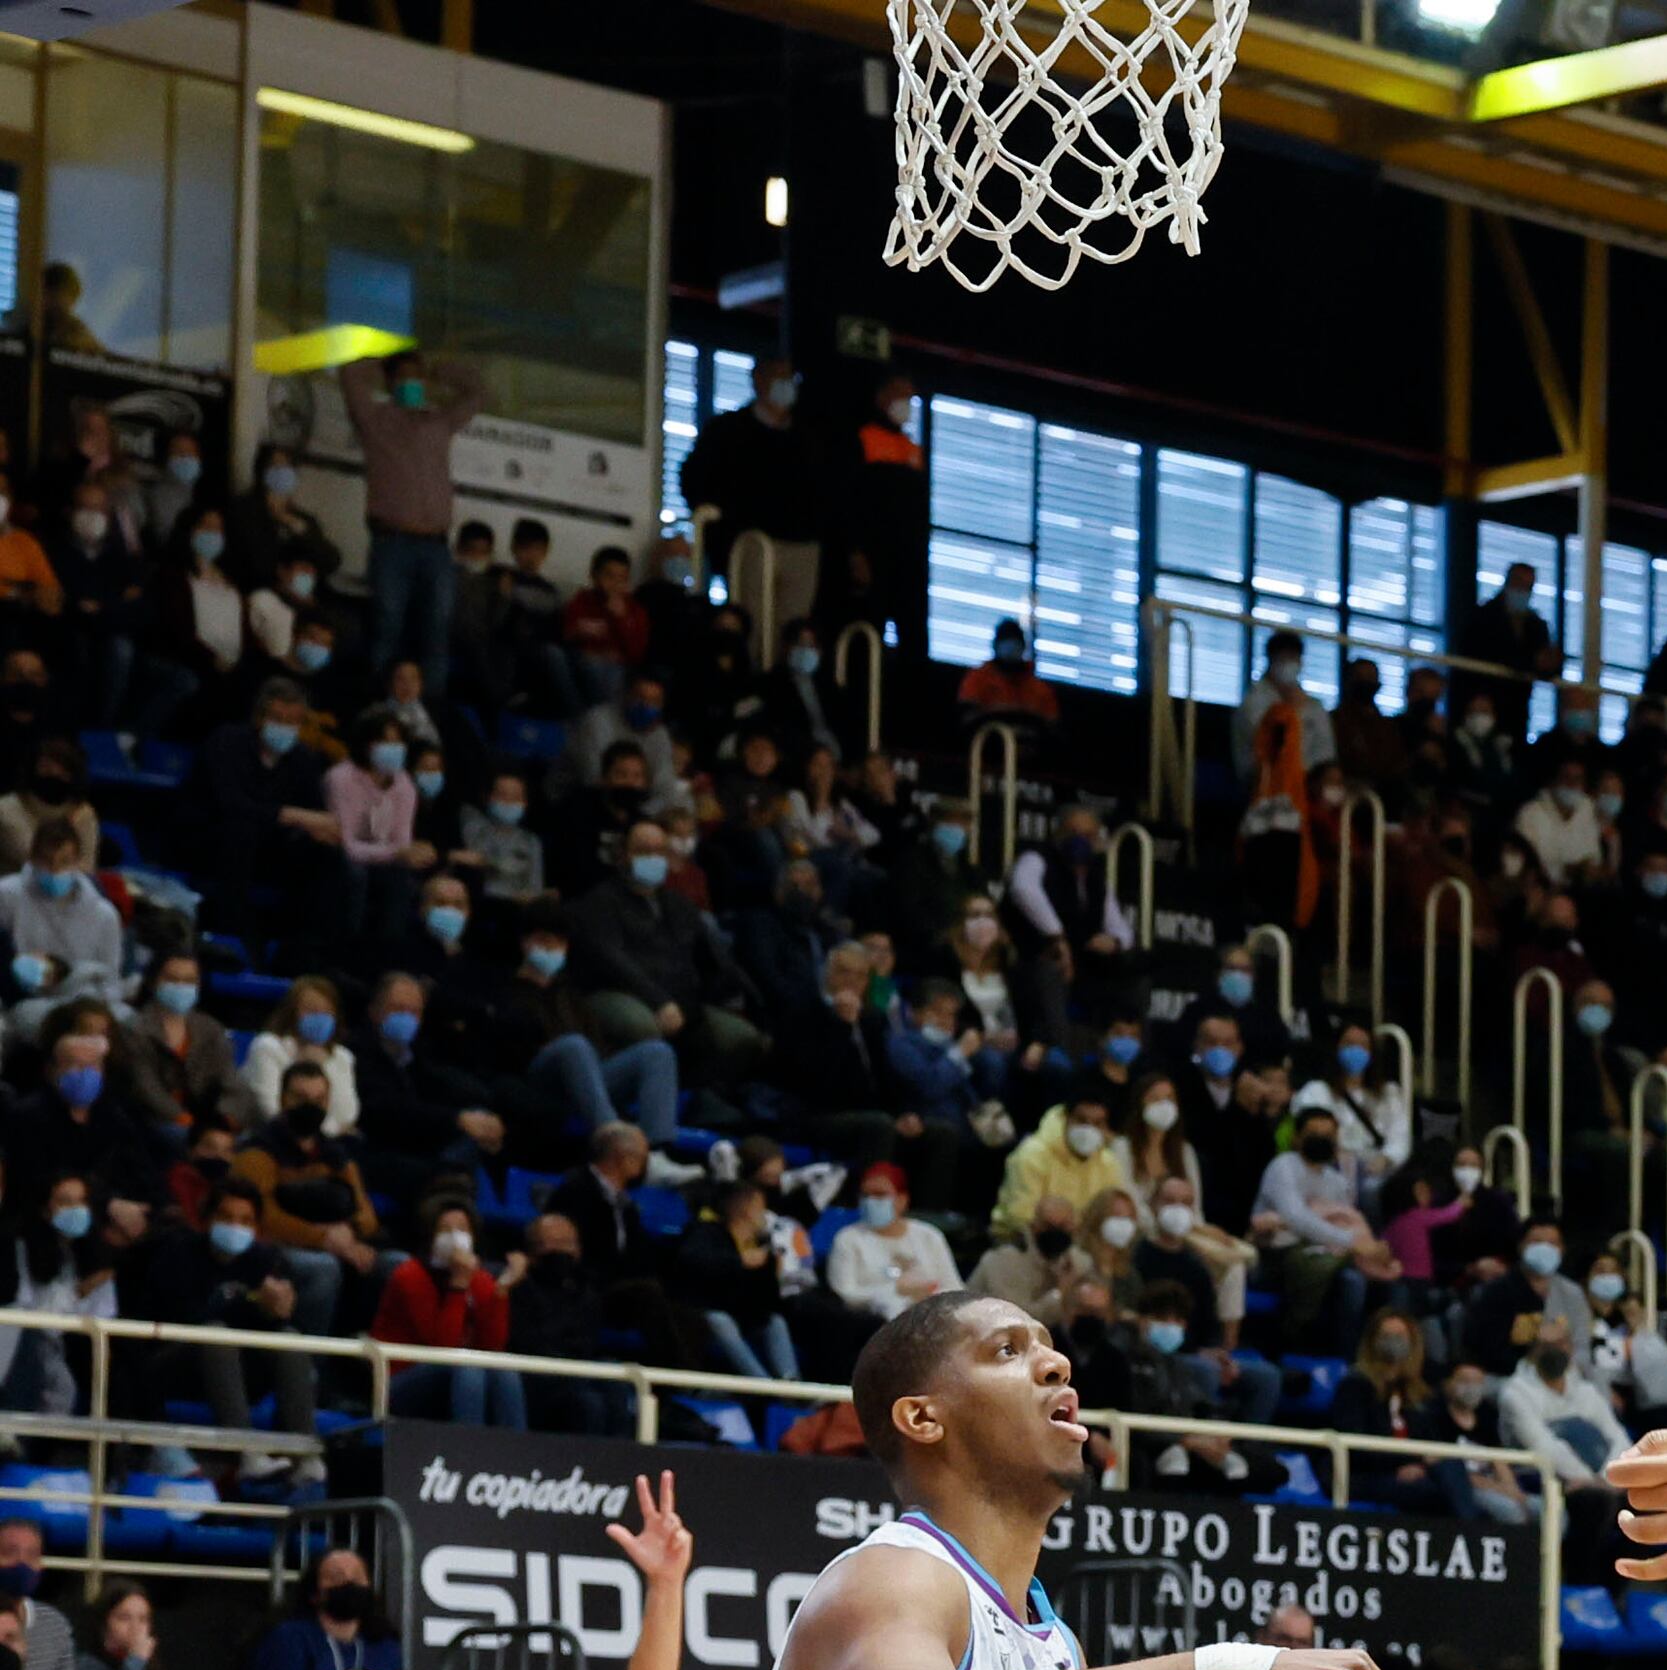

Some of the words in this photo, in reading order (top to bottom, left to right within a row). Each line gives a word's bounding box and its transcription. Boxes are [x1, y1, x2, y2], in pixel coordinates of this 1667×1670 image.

[420, 1455, 462, 1501] tu
[466, 1465, 630, 1519] copiadora
[1038, 1500, 1230, 1562] GRUPO
[1253, 1505, 1508, 1581] LEGISLAE
